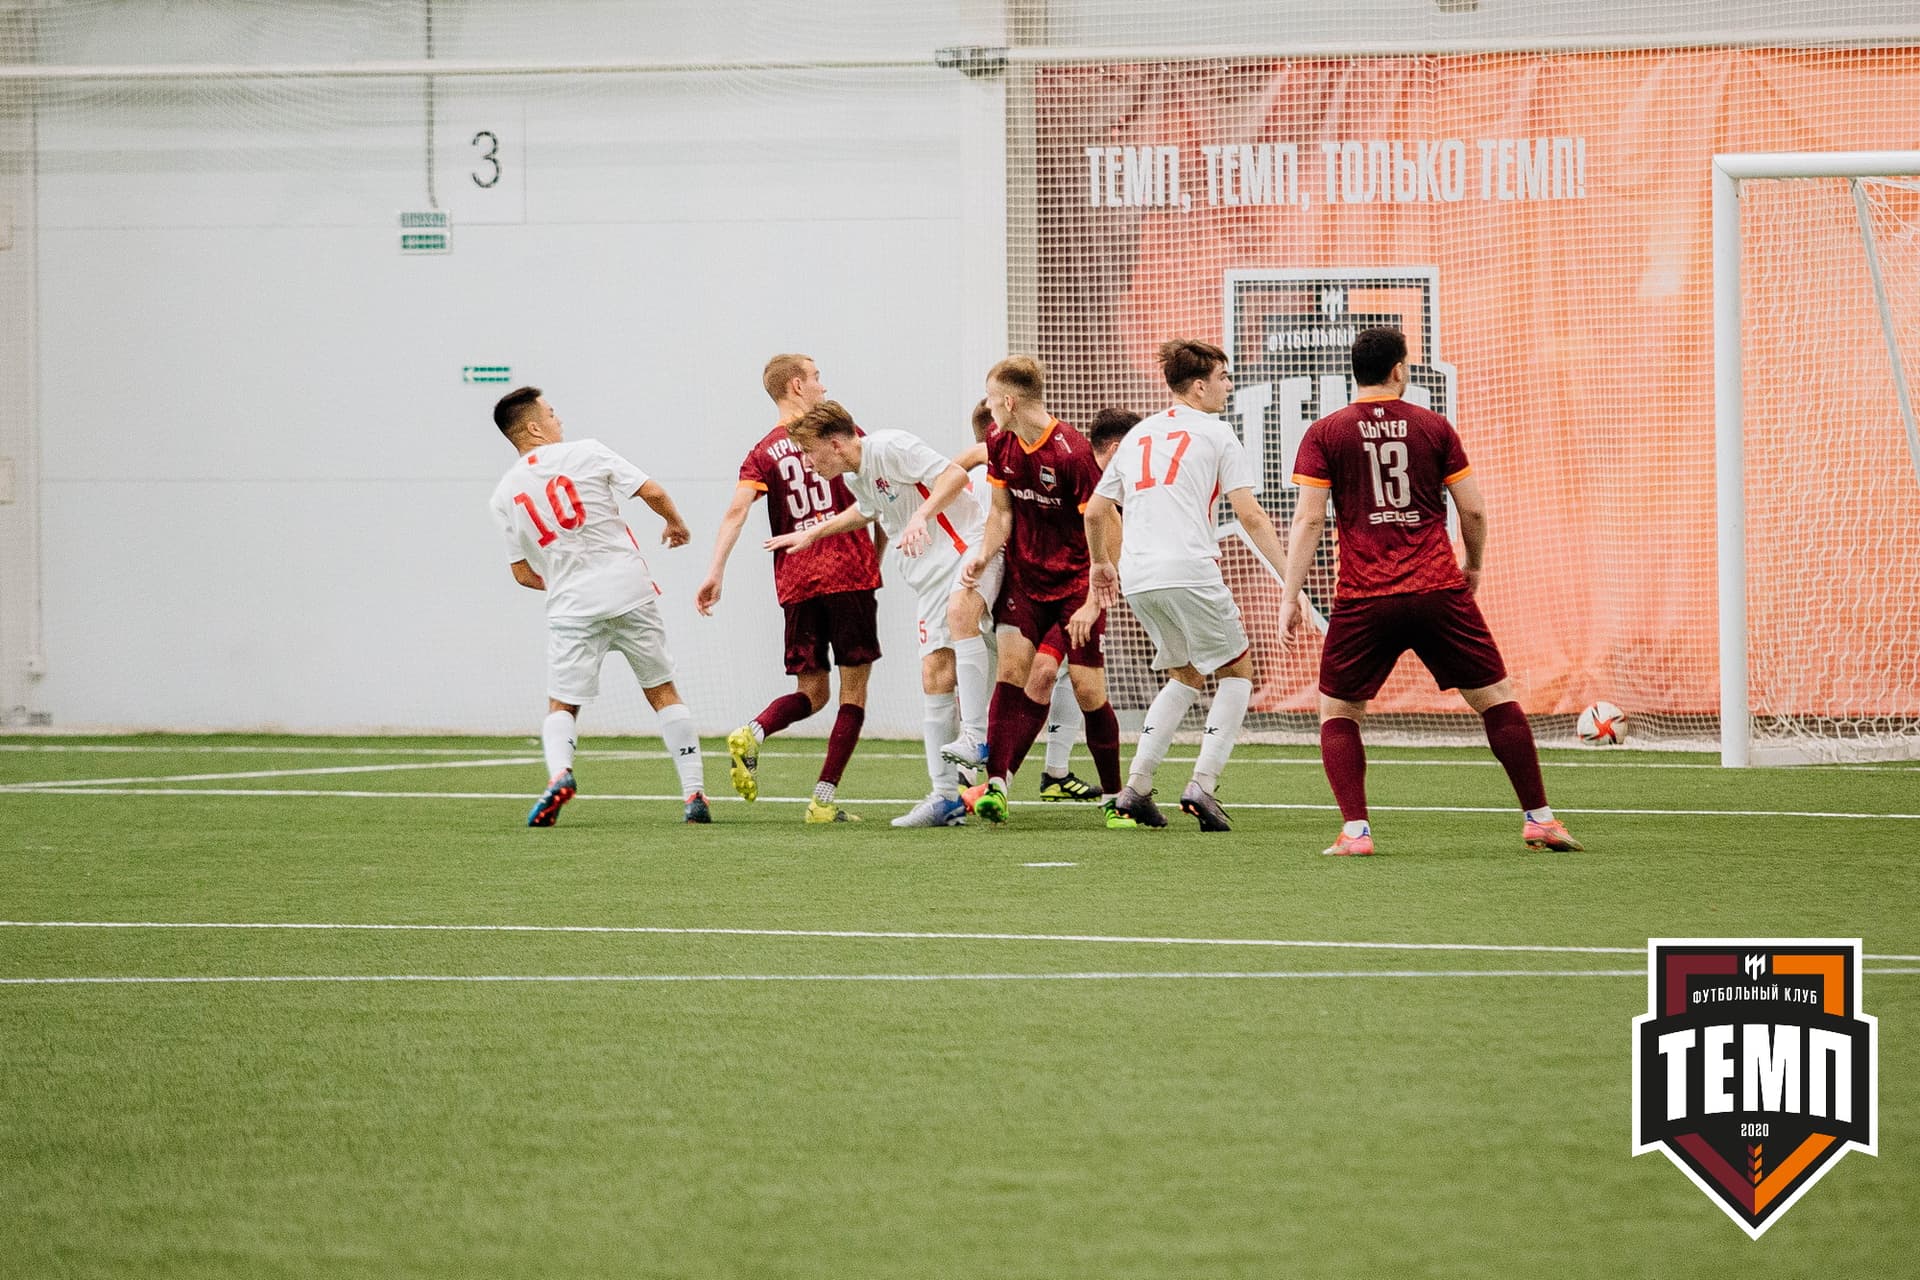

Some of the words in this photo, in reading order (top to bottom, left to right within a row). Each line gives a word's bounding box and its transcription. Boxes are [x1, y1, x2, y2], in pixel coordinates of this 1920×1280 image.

[471, 130, 502, 189] 3
[1084, 145, 1192, 214] ТЕМП,
[1201, 143, 1311, 212] ТЕМП,
[1321, 139, 1466, 204] ТОЛЬКО
[1478, 137, 1586, 201] ТЕМП!
[1134, 430, 1192, 491] 17
[1358, 419, 1408, 439] СЫЧЕВ
[779, 455, 833, 519] 33
[1363, 441, 1411, 508] 13
[513, 474, 587, 548] 10
